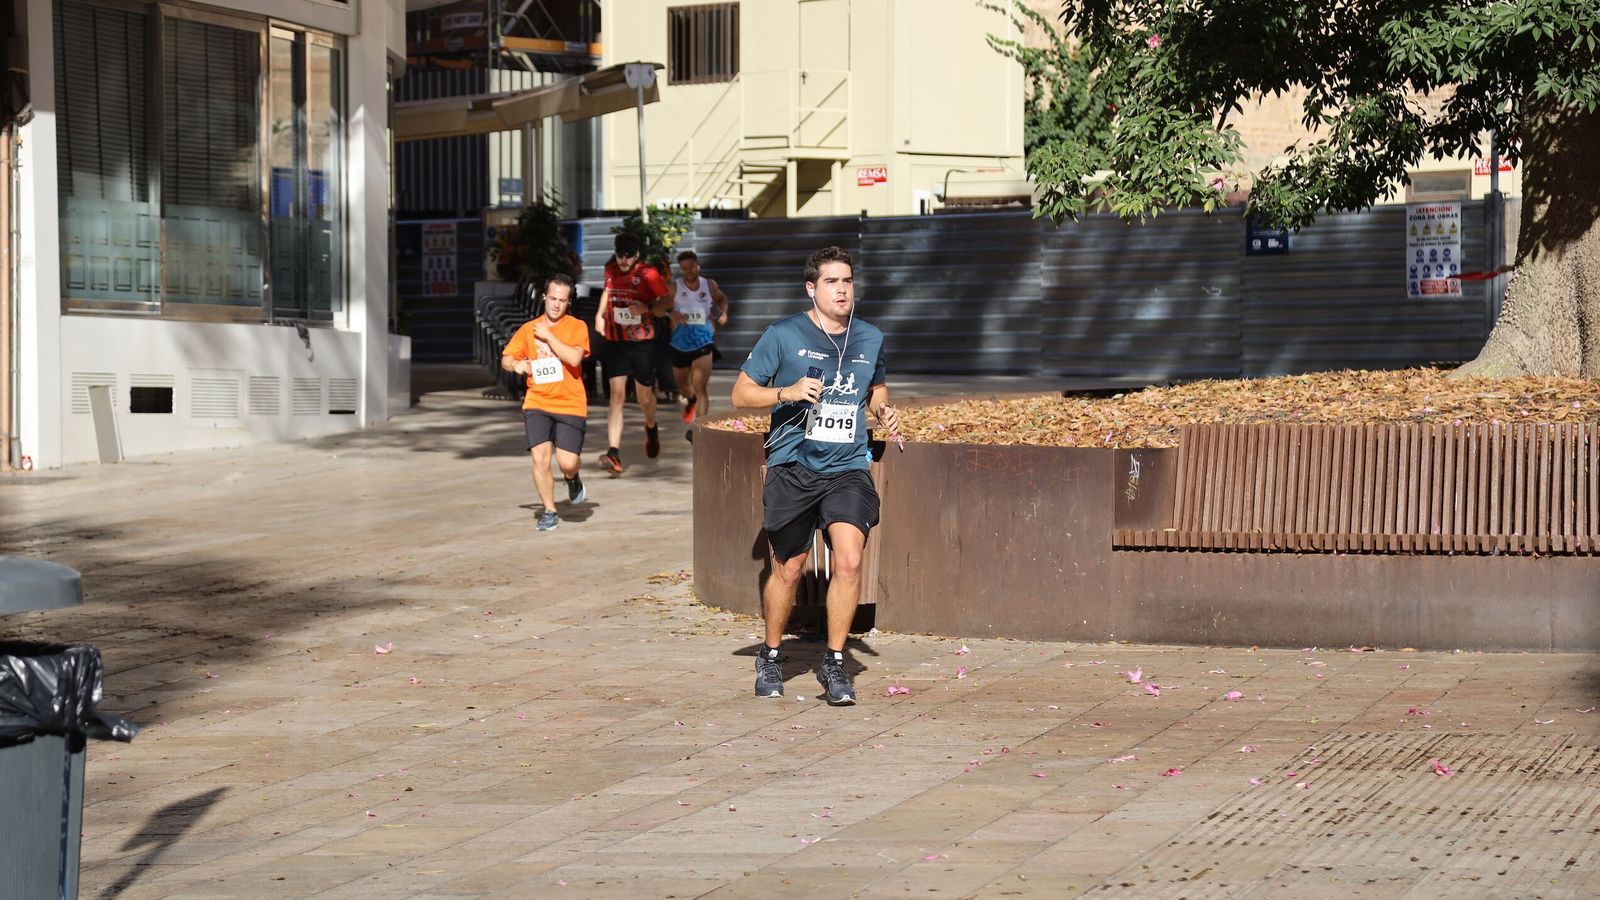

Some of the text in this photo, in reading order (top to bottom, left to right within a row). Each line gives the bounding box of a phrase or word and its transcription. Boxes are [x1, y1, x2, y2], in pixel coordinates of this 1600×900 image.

[857, 167, 887, 178] REMSA
[536, 366, 557, 377] 503
[815, 416, 853, 430] 1019
